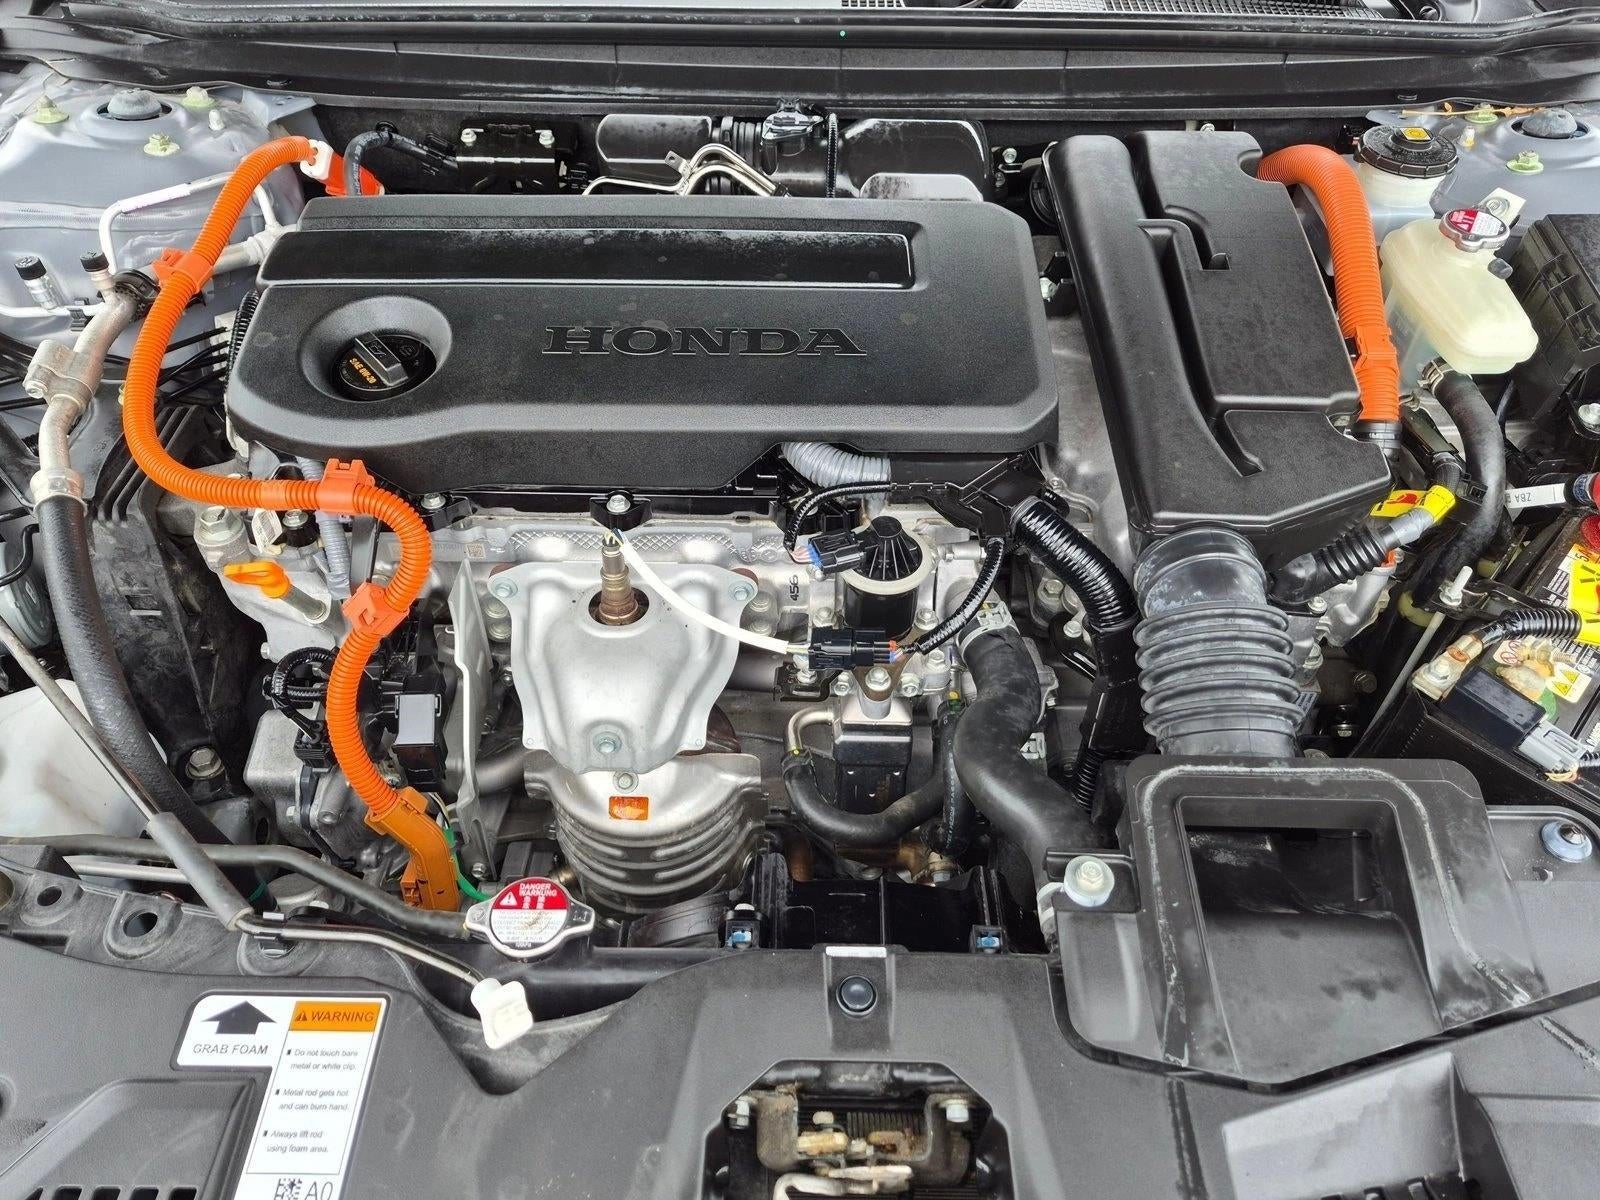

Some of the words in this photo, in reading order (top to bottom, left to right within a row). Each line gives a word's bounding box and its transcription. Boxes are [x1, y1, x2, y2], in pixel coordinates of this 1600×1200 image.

[541, 325, 867, 356] HONDA
[349, 358, 363, 370] SAE
[789, 574, 800, 601] 456
[311, 1011, 374, 1022] WARNING
[192, 1043, 228, 1055] GRAB
[231, 1044, 269, 1055] FOAM
[294, 1048, 305, 1056] Do
[319, 1049, 340, 1057] touch
[341, 1049, 358, 1057] bare
[290, 1062, 311, 1070] metal
[322, 1062, 341, 1070] white
[282, 1088, 304, 1096] Metal
[305, 1088, 318, 1096] rod
[318, 1089, 335, 1098] gets
[309, 1102, 327, 1110] burn
[270, 1130, 298, 1139] Always
[299, 1130, 309, 1138] lift
[309, 1130, 324, 1138] rod
[266, 1144, 288, 1154] using
[288, 1144, 308, 1153] foam
